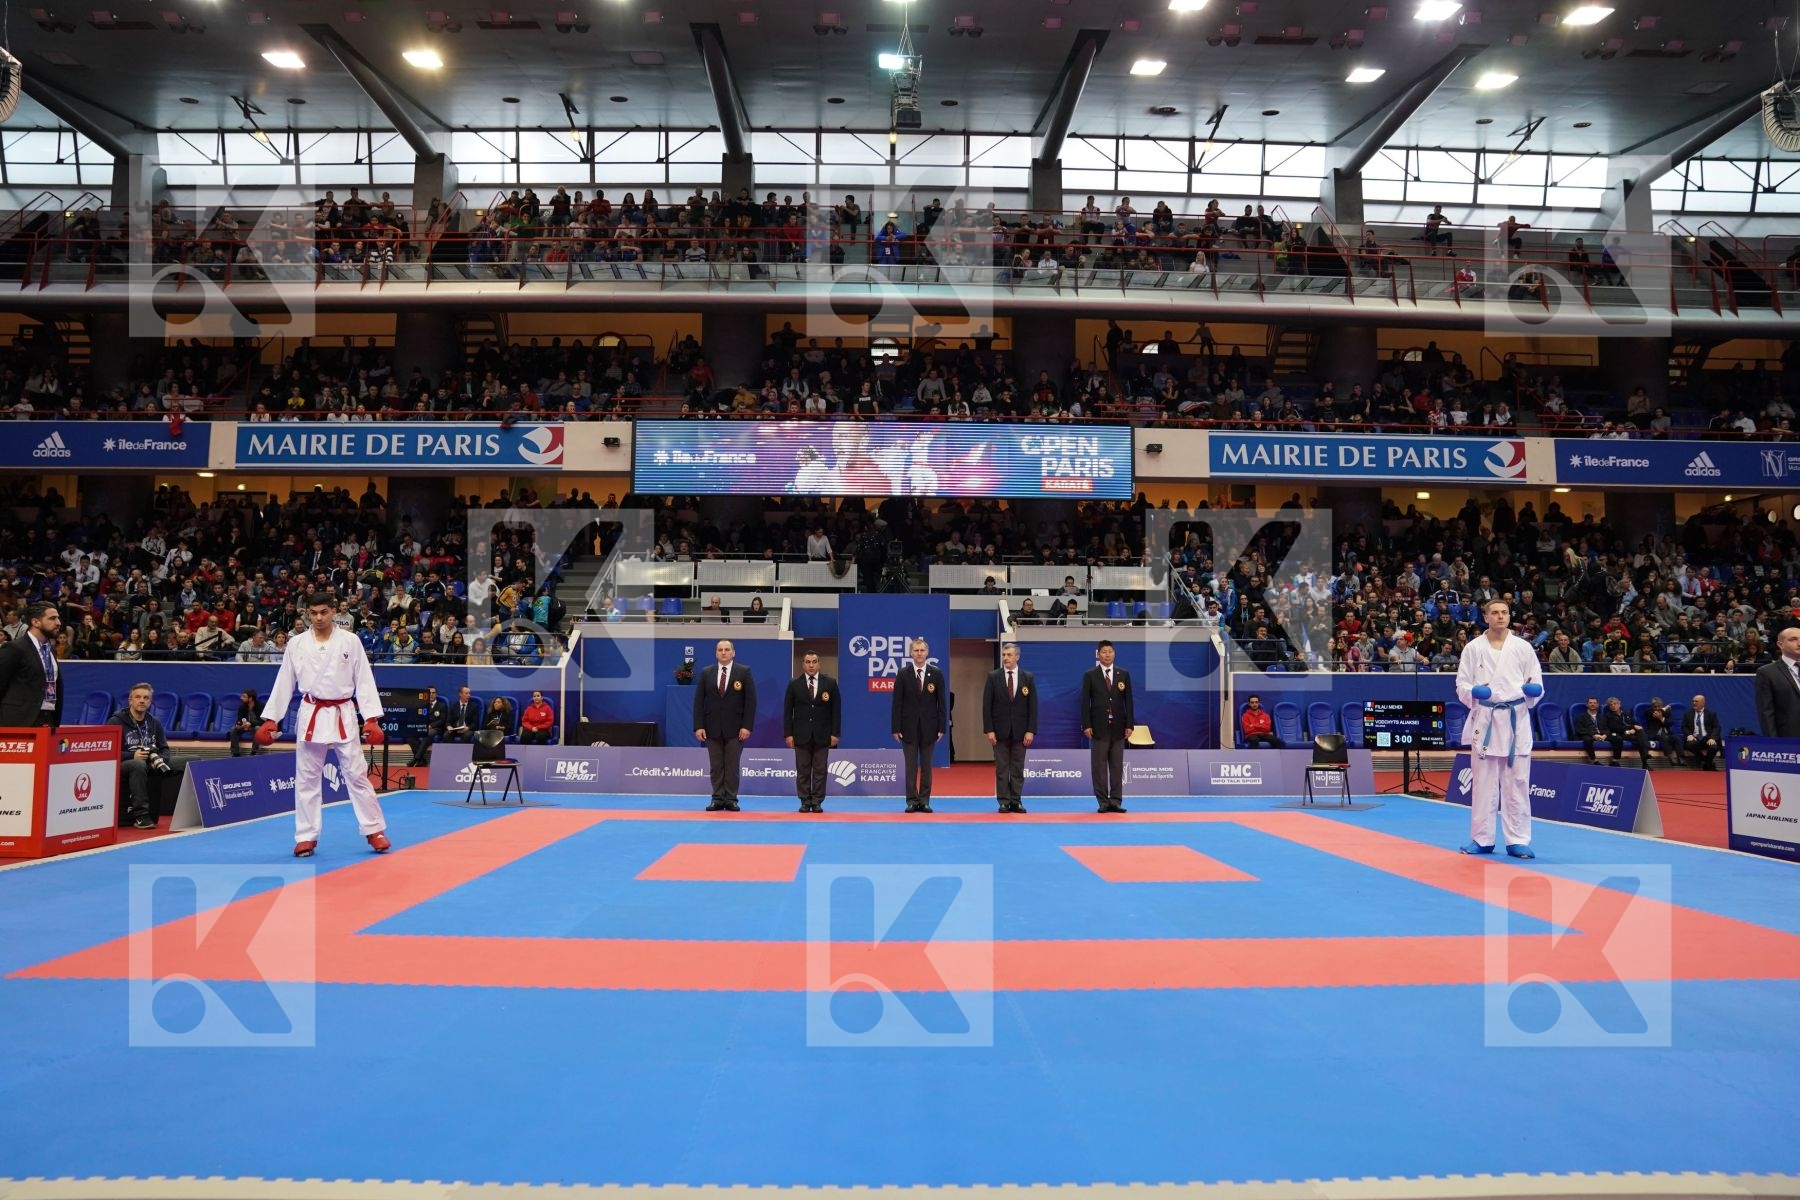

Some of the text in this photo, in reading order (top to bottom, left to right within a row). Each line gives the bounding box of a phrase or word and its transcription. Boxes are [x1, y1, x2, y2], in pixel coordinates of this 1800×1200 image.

[248, 434, 500, 456] MAIRIE DE PARIS
[1021, 436, 1098, 455] OPEN
[32, 447, 71, 458] adidas
[1222, 443, 1468, 469] MAIRIE DE PARIS
[1041, 458, 1115, 478] PARIS
[1684, 466, 1721, 477] adidas
[382, 722, 398, 731] 3:00
[1394, 734, 1412, 744] 3:00
[556, 761, 590, 774] RMC
[632, 767, 704, 777] Crédit Mutuel
[1220, 764, 1252, 777] RMC
[564, 772, 596, 780] SPORT
[1529, 784, 1556, 798] France
[1586, 786, 1614, 804] RMC
[78, 804, 104, 812] AIRLINES
[1590, 801, 1618, 814] SPORT
[1767, 815, 1798, 824] AIRLINES
